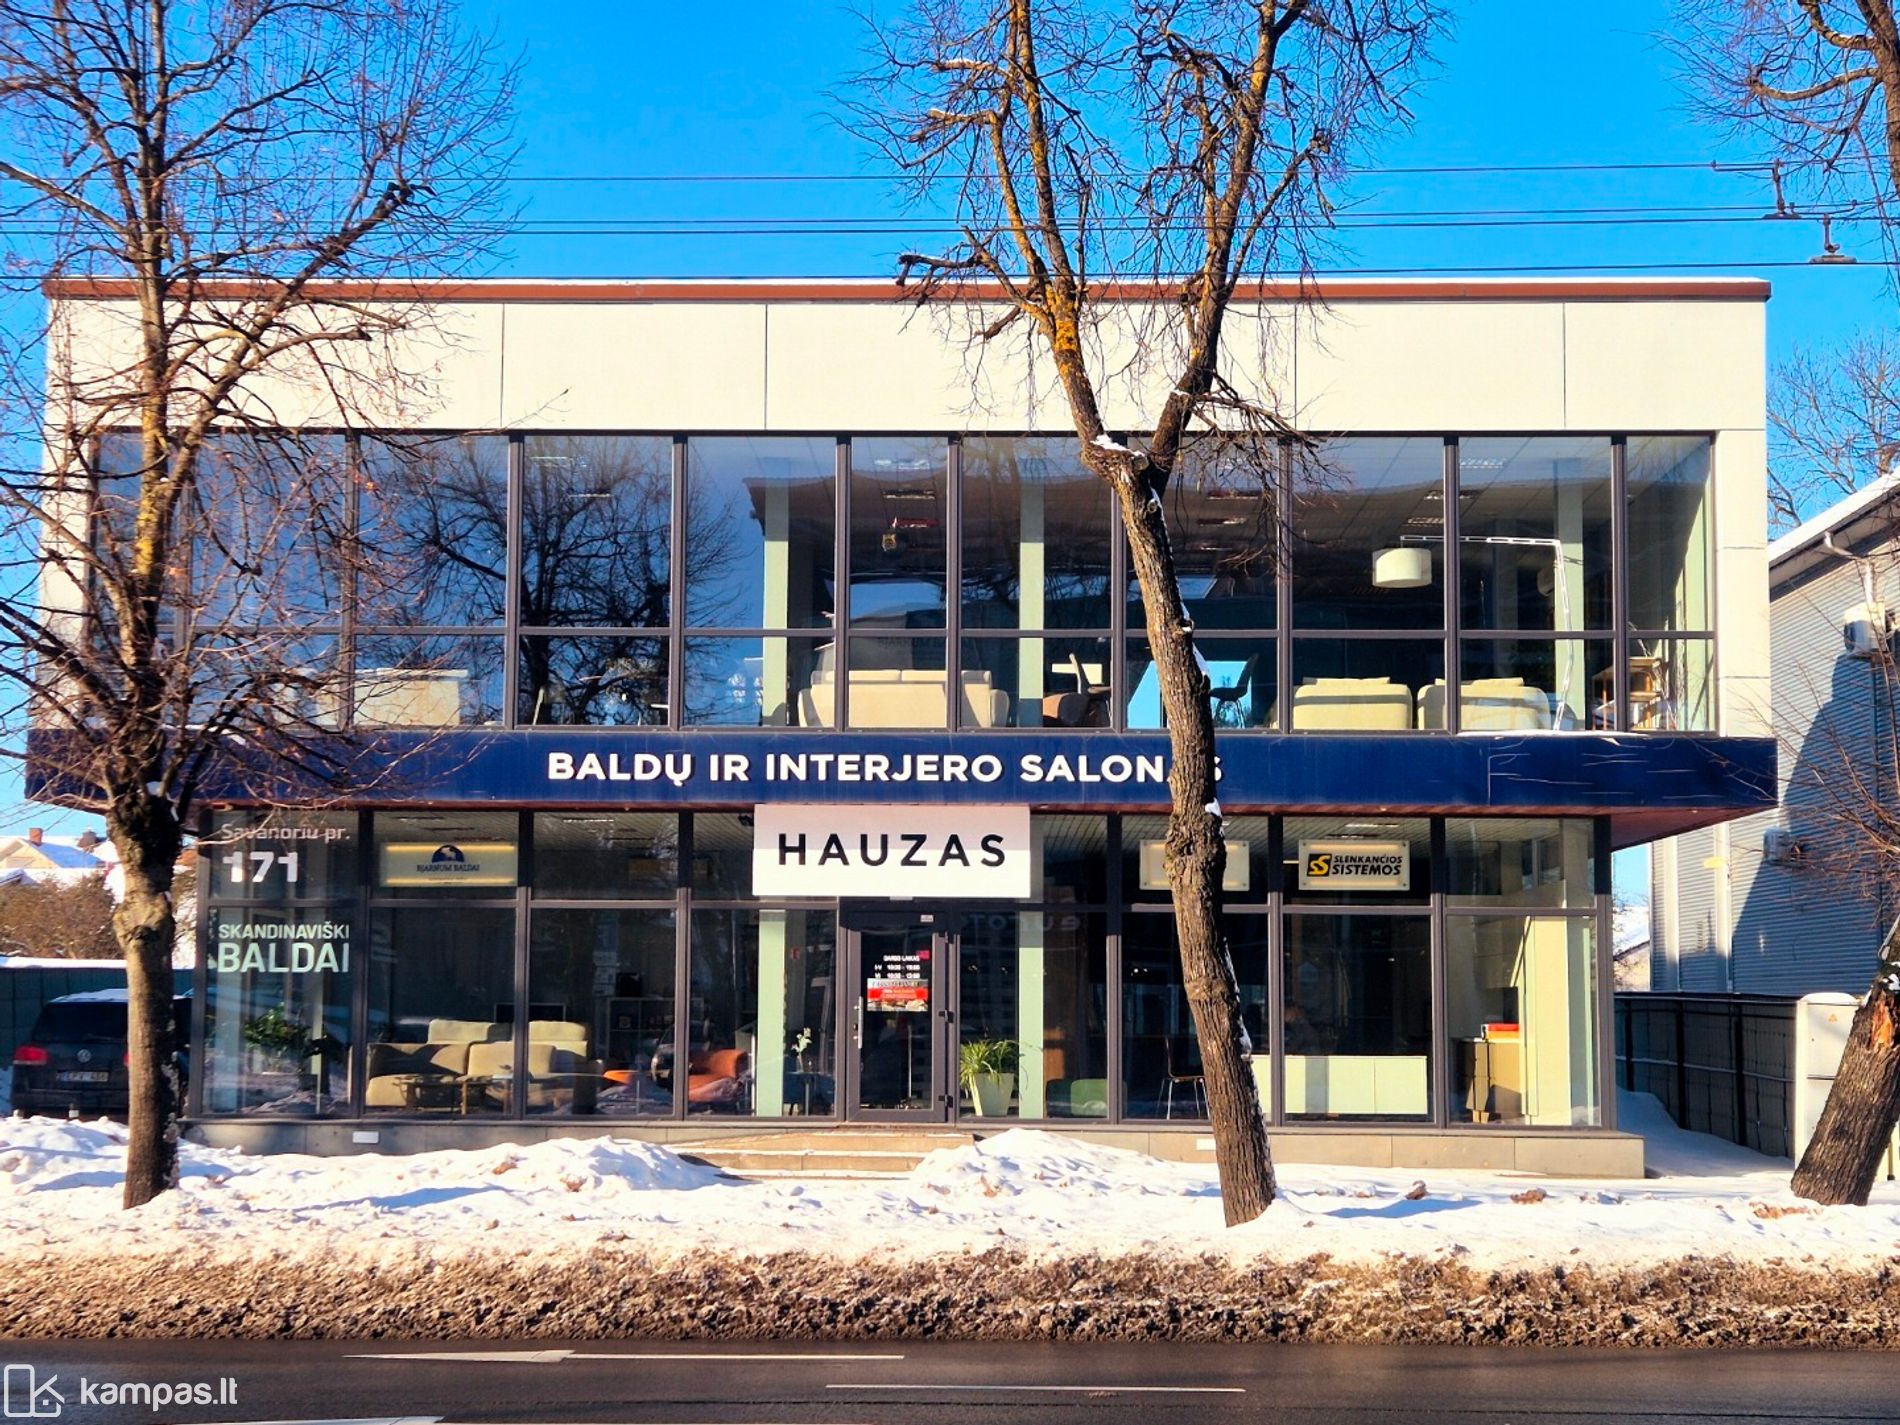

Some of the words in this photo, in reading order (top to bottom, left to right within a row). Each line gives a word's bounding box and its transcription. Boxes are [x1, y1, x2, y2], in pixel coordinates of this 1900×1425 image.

[548, 753, 692, 787] BALDŲ
[709, 754, 749, 782] IR
[766, 753, 1003, 783] INTERJERO
[1020, 754, 1222, 783] SALON
[325, 827, 350, 844] pr.
[778, 833, 1005, 867] HAUZAS
[222, 851, 299, 883] 171
[1332, 864, 1401, 875] SISTEMOS
[218, 921, 350, 940] SKANDINAVIŠKI
[217, 942, 350, 973] BALDAI
